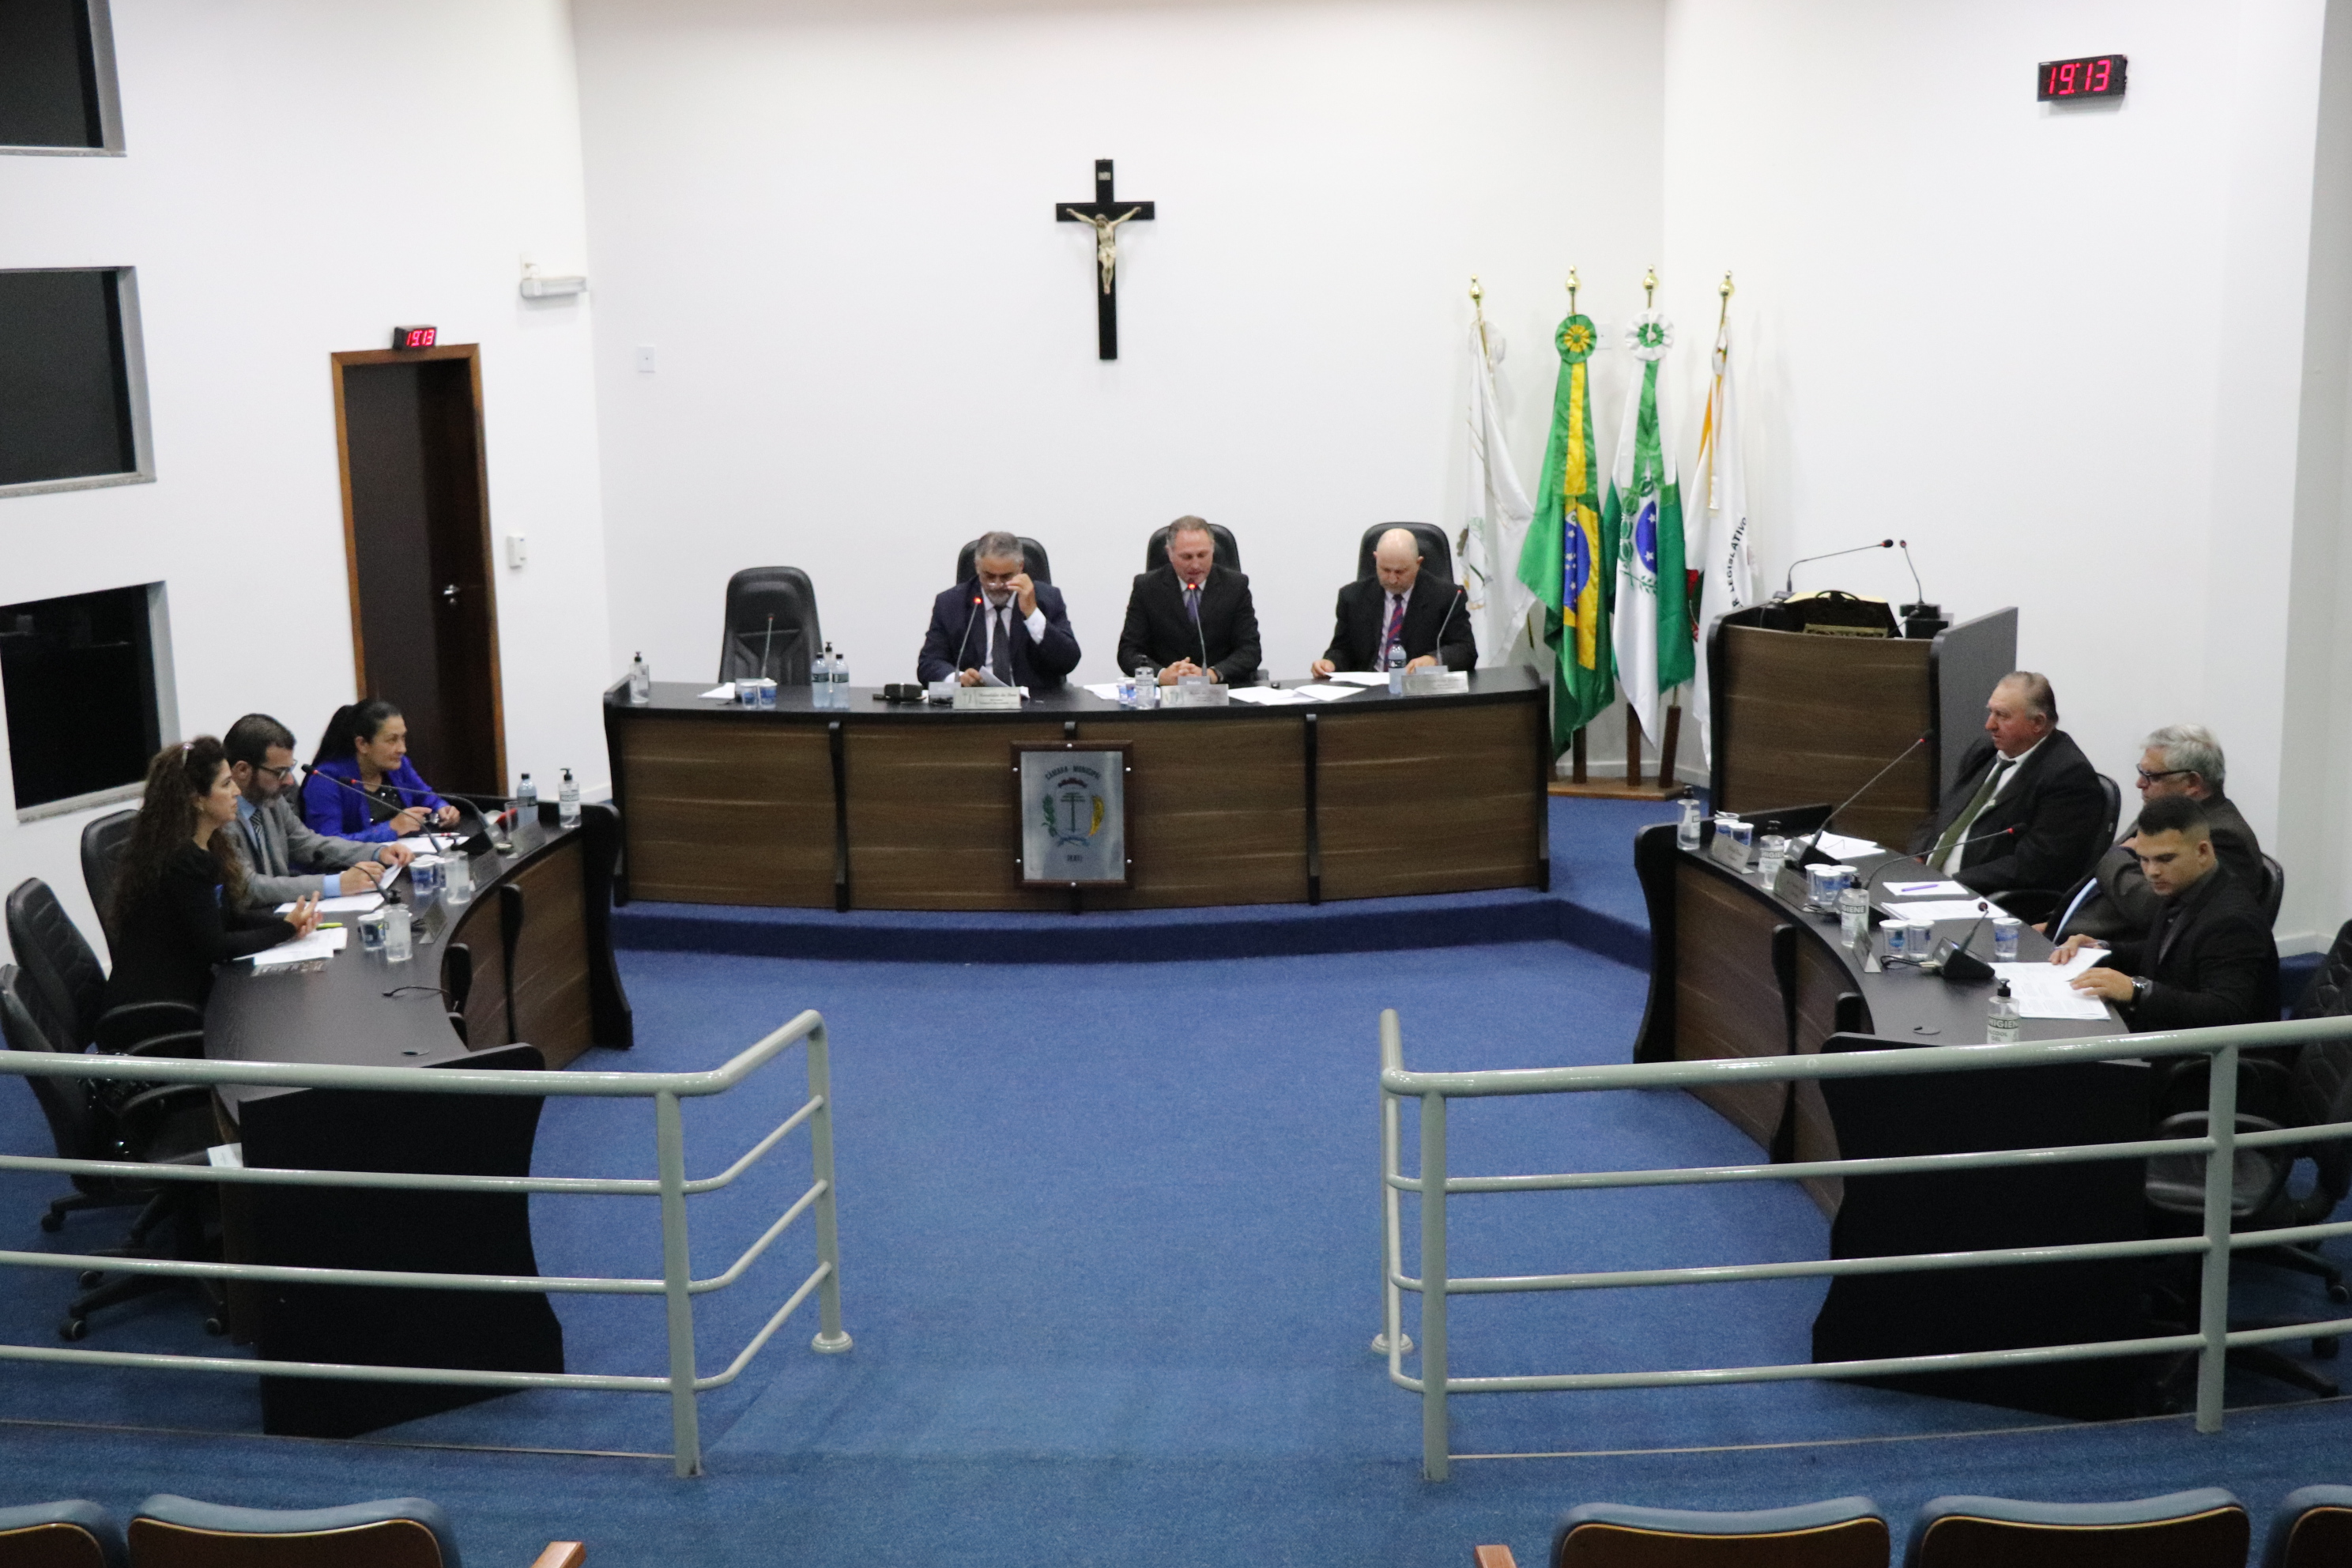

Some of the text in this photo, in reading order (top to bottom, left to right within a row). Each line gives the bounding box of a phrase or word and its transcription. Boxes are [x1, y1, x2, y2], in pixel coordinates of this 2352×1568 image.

[1727, 517, 1747, 593] LEGISLATIVO
[1841, 905, 1864, 914] GIENE
[1988, 1017, 2018, 1028] HIGIEN
